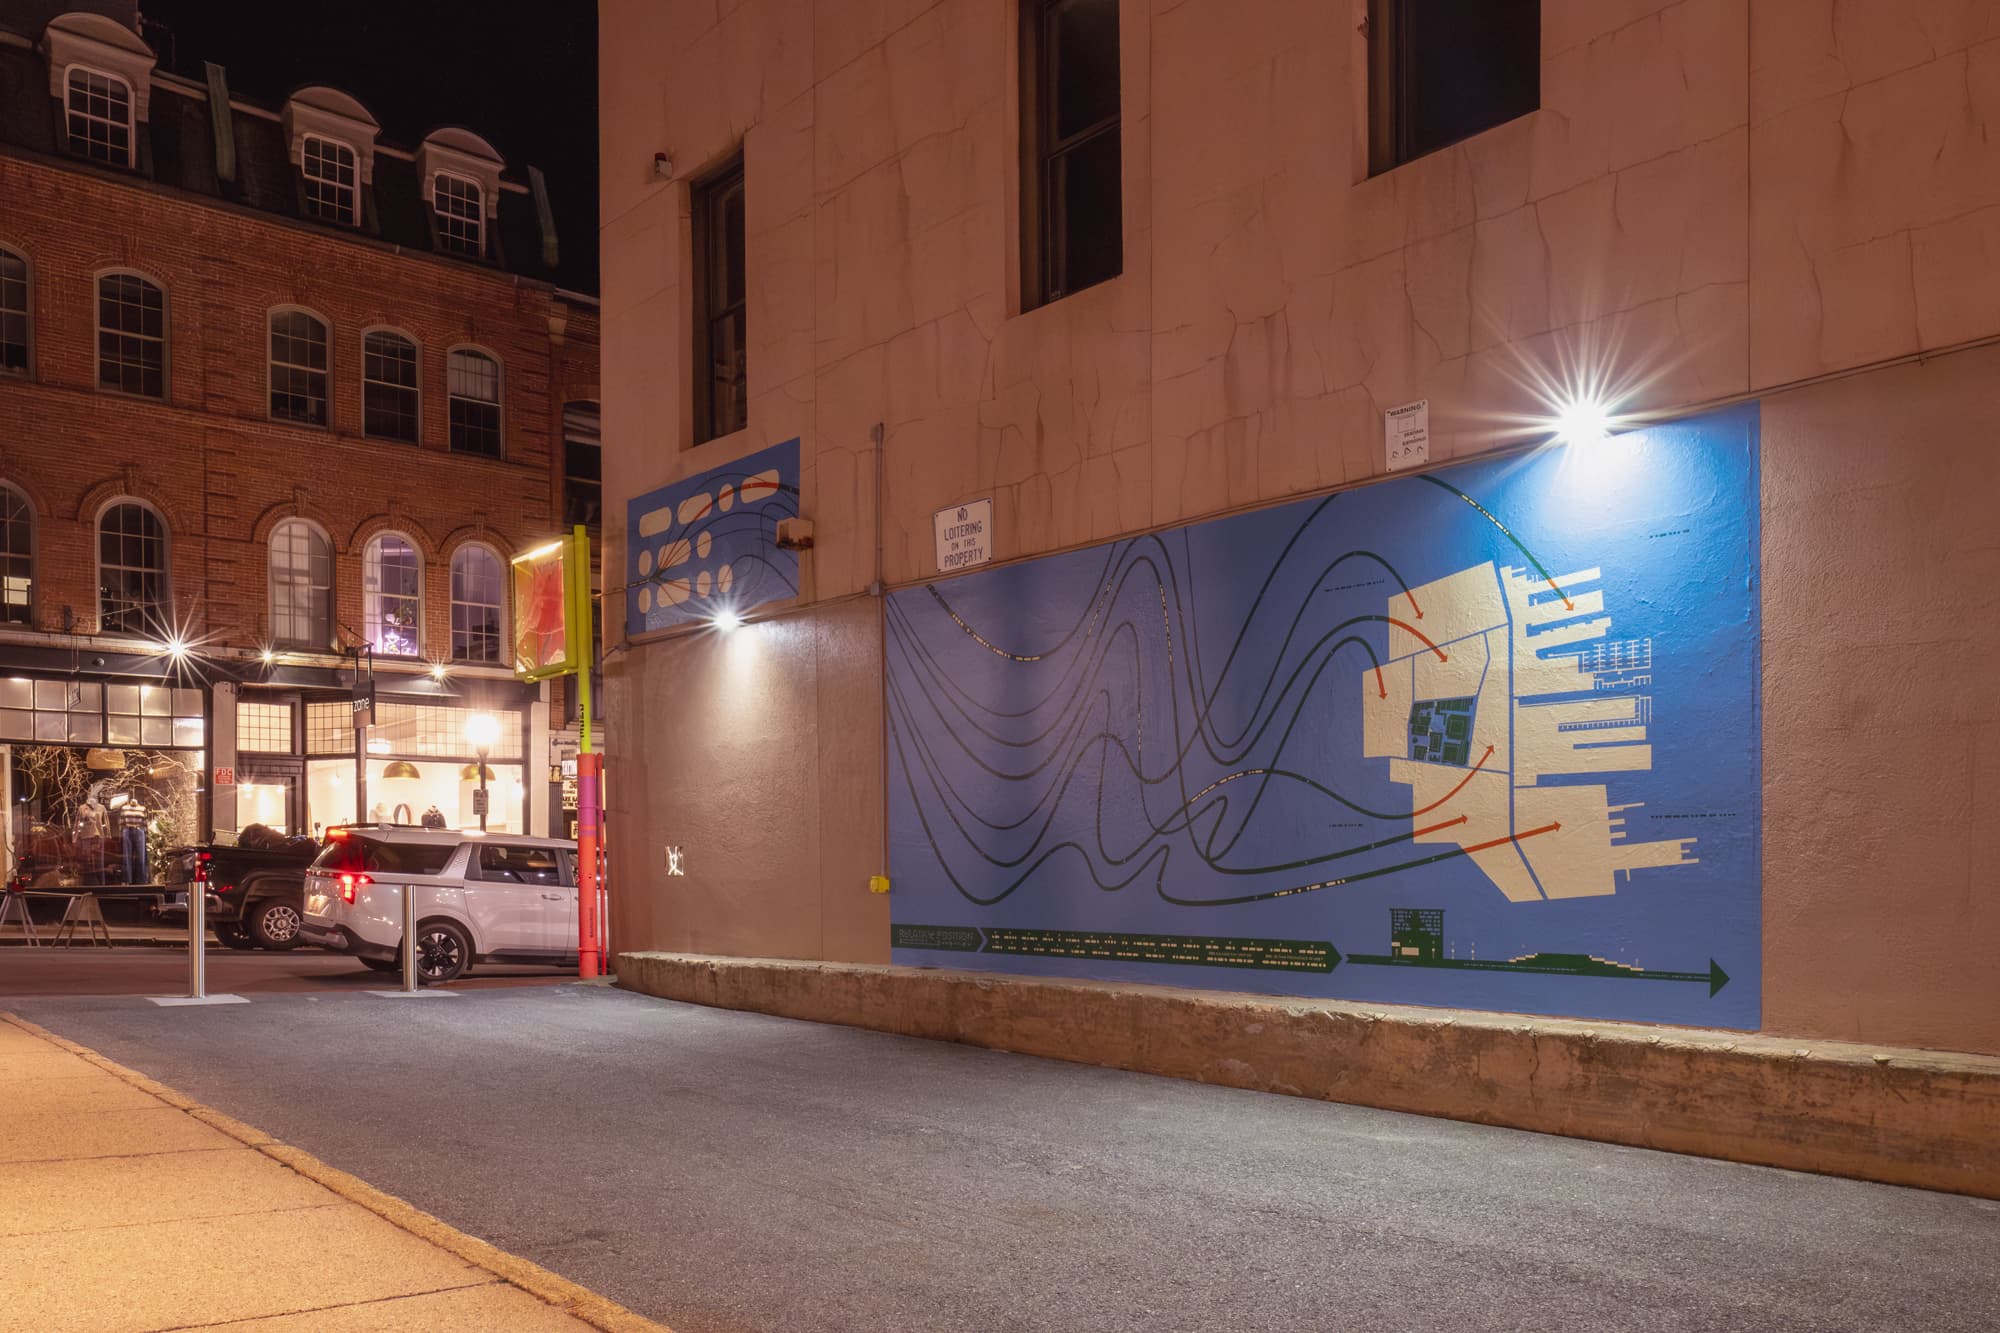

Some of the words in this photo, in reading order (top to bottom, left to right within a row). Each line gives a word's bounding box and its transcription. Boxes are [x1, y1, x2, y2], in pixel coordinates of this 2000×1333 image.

[957, 508, 968, 522] NO
[944, 520, 982, 541] LOITERING
[951, 542, 959, 551] ON
[964, 537, 976, 547] THIS
[944, 547, 983, 568] PROPERTY
